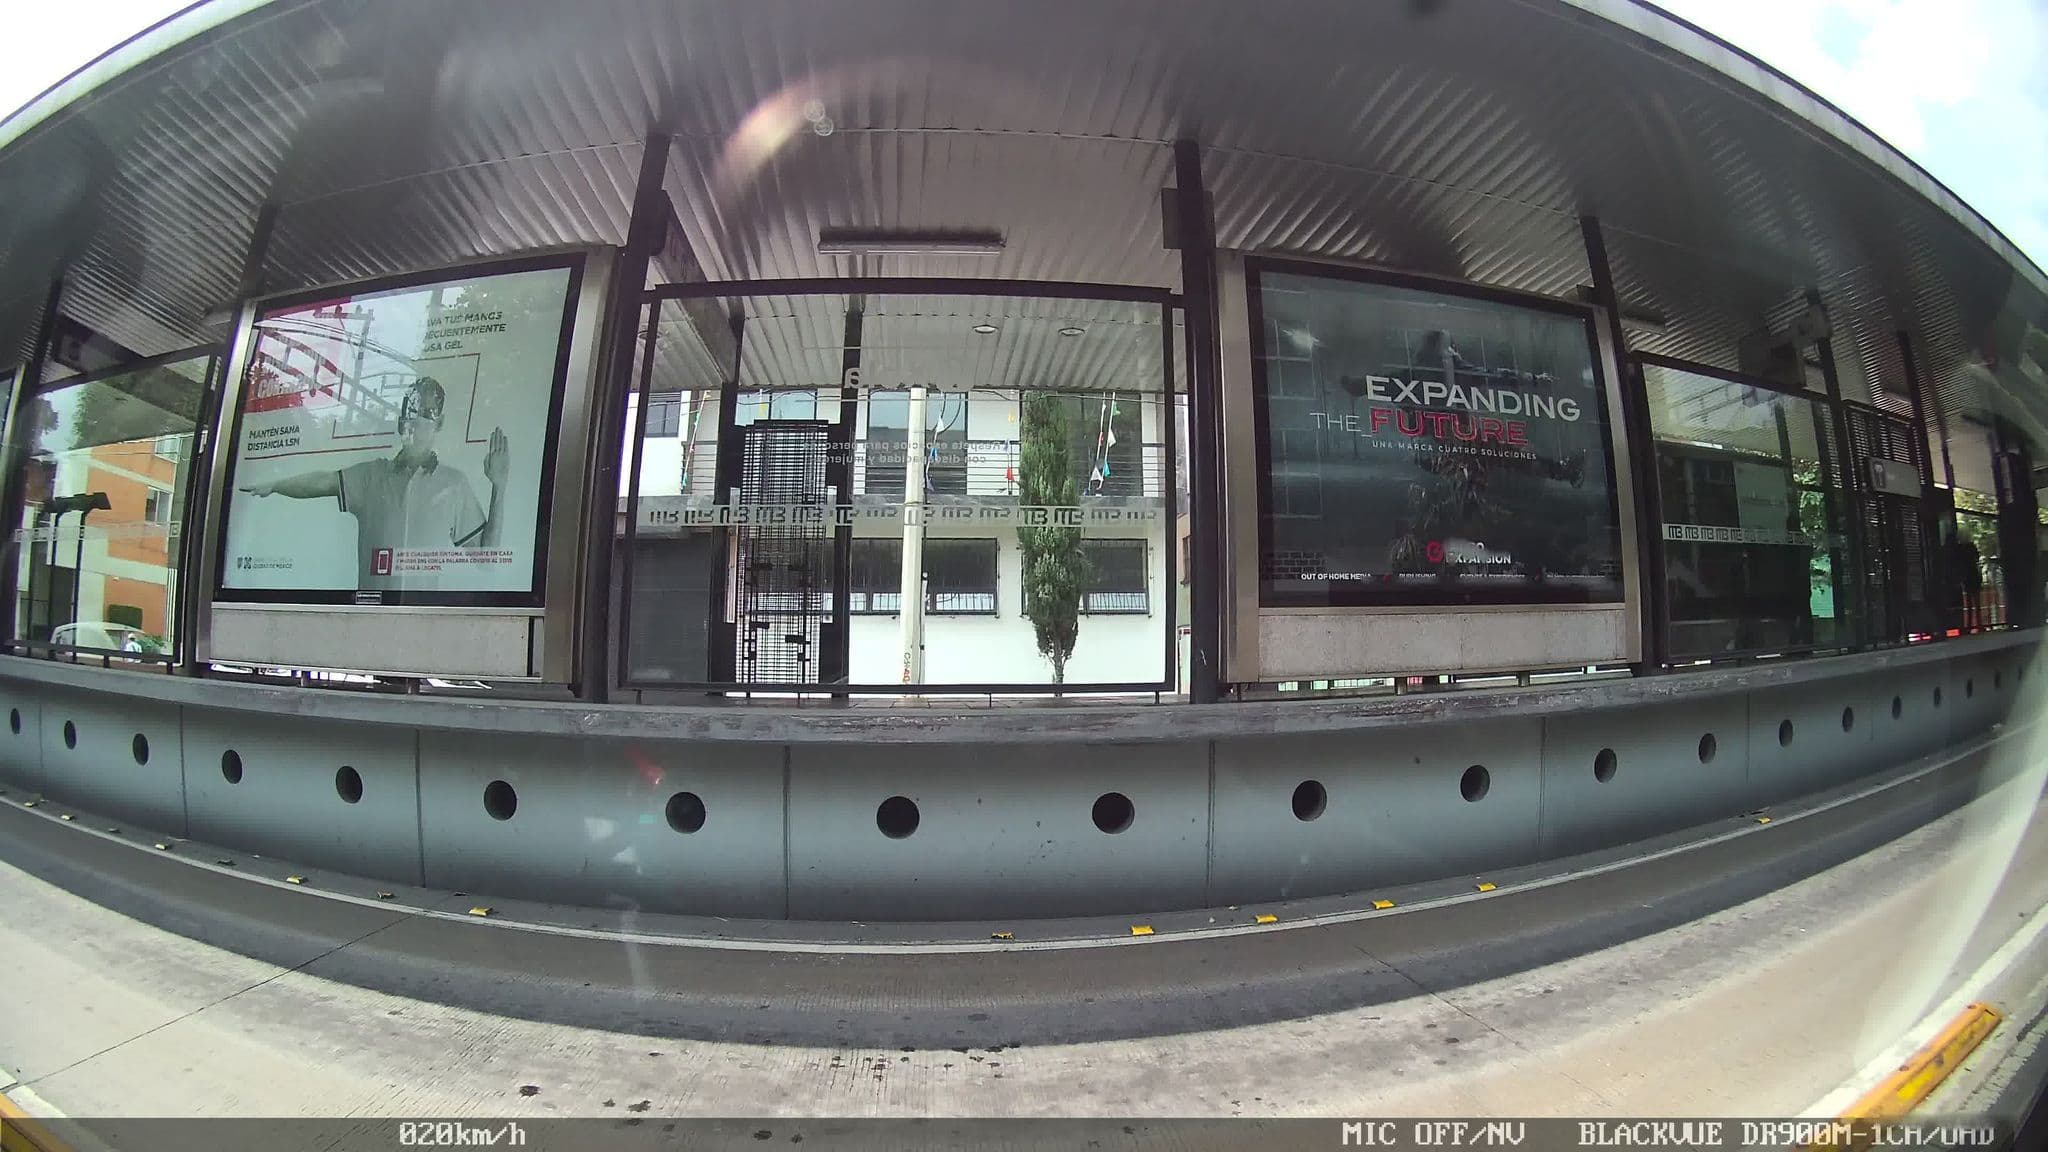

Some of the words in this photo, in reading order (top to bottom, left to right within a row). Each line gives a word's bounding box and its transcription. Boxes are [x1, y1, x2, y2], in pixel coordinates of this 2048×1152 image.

[444, 340, 463, 350] GEL
[1365, 375, 1581, 422] EXPANDING
[1369, 406, 1529, 446] FUTURE
[247, 439, 284, 451] DISTANCIA
[1372, 440, 1393, 449] UNA
[1398, 443, 1434, 452] MARCA
[1438, 445, 1477, 455] CUATRO
[1481, 449, 1538, 460] SOLUCIONES
